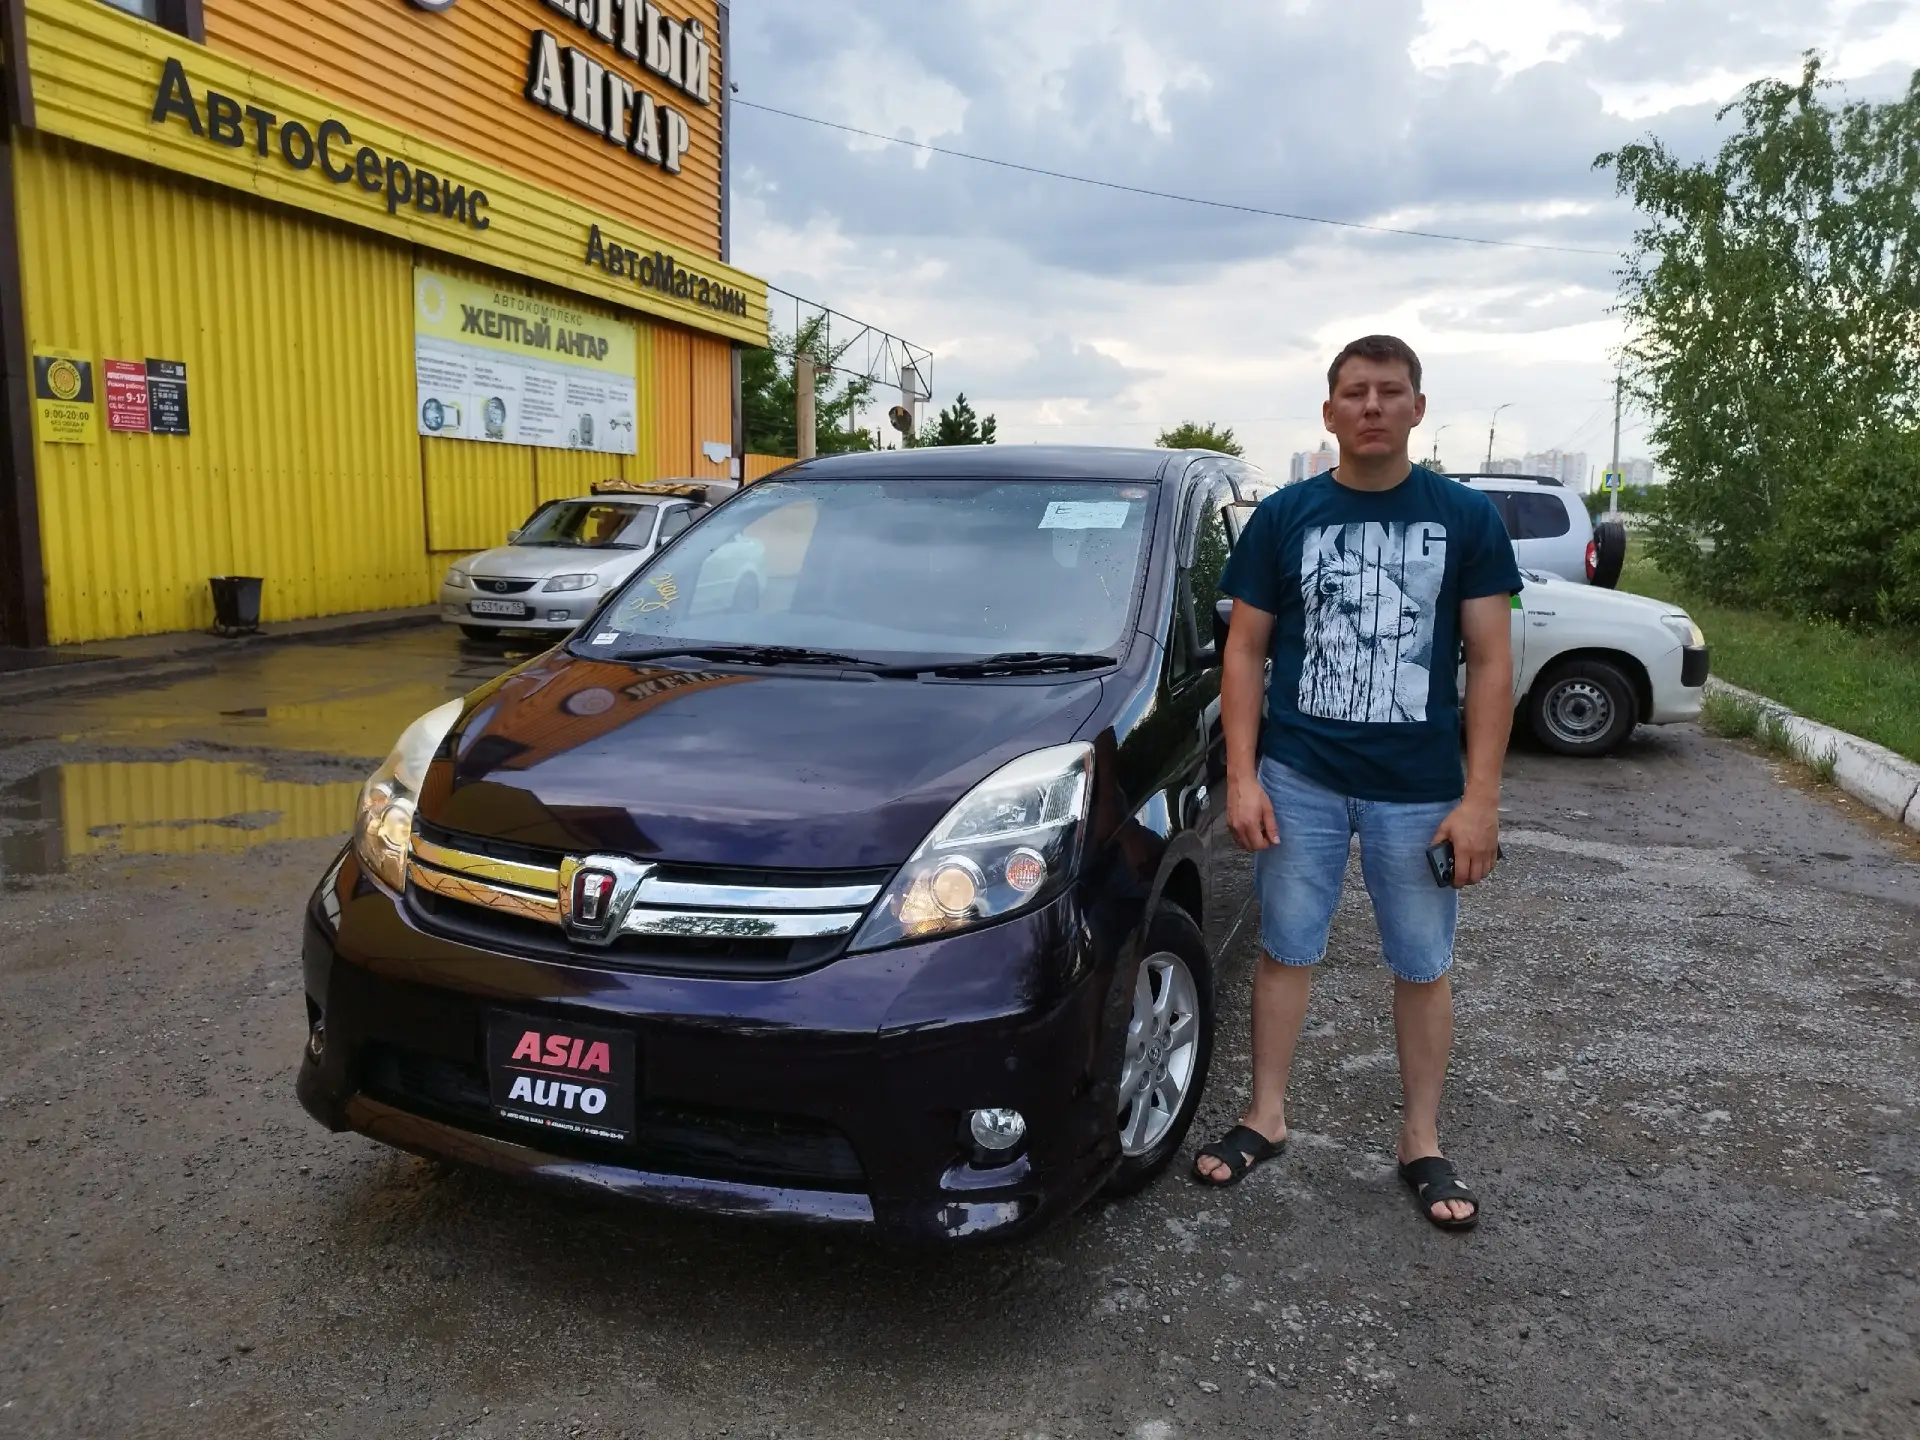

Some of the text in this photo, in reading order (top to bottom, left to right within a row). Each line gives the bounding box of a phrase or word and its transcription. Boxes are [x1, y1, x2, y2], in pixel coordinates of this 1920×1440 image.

[543, 0, 711, 105] ЛТЫЙ
[526, 30, 690, 174] АНГАР
[151, 57, 490, 231] АвтоСервис
[586, 224, 747, 319] АвтоМагазин
[460, 303, 609, 361] ЖЕЛТЫЙ АНГАР
[493, 293, 584, 326] АВТОКОМПЛЕКС
[126, 392, 147, 404] 9-17
[1302, 521, 1447, 562] KING
[512, 1031, 610, 1073] ASIA
[508, 1076, 607, 1114] AUTO
